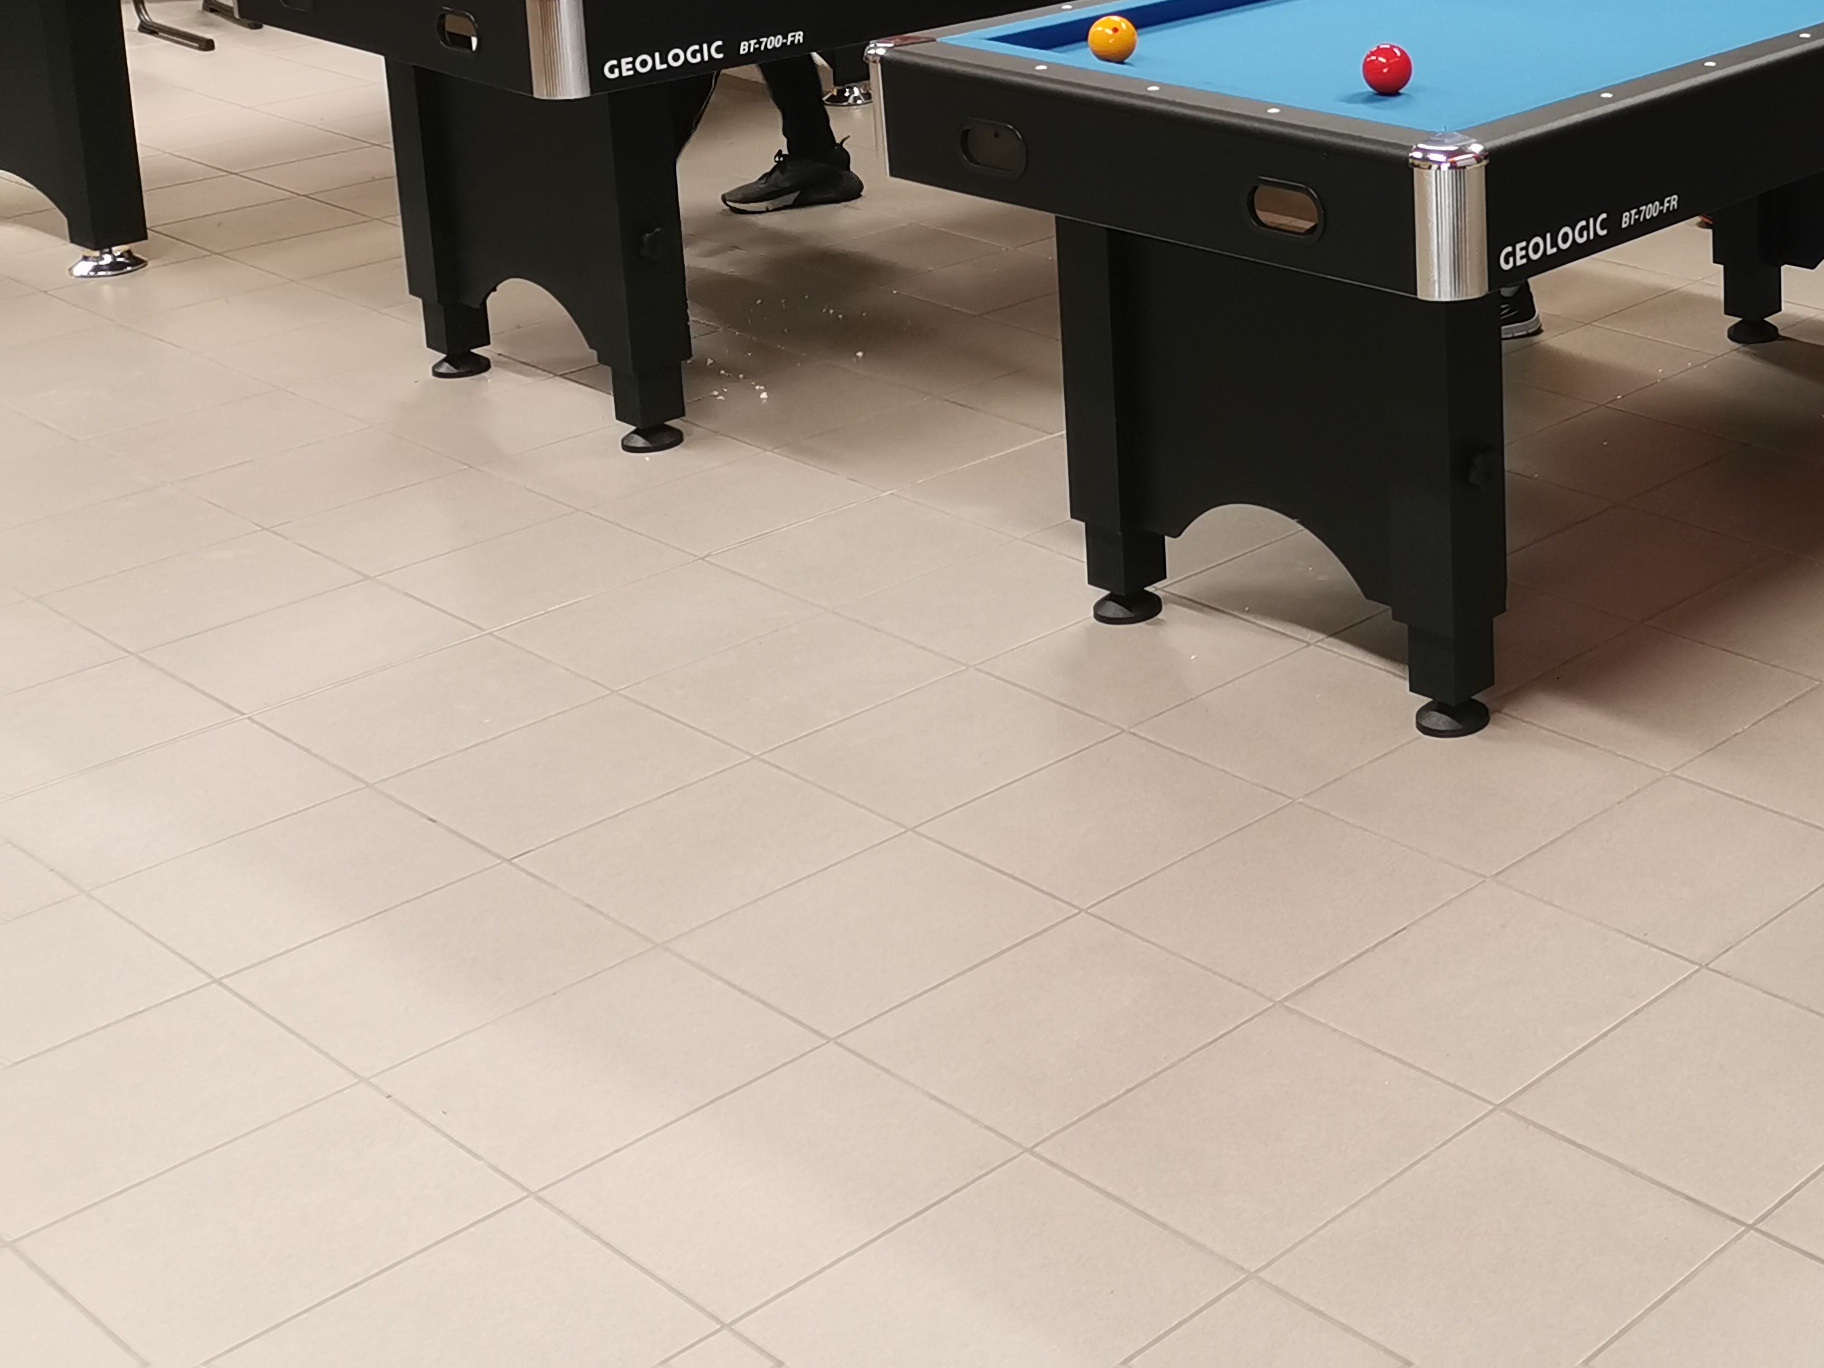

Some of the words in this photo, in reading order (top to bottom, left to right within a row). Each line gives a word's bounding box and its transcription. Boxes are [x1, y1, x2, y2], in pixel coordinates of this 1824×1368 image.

[739, 30, 804, 55] BT-700-FR
[1499, 212, 1608, 271] GEOLOGIC
[1621, 194, 1679, 229] BT-700-FR
